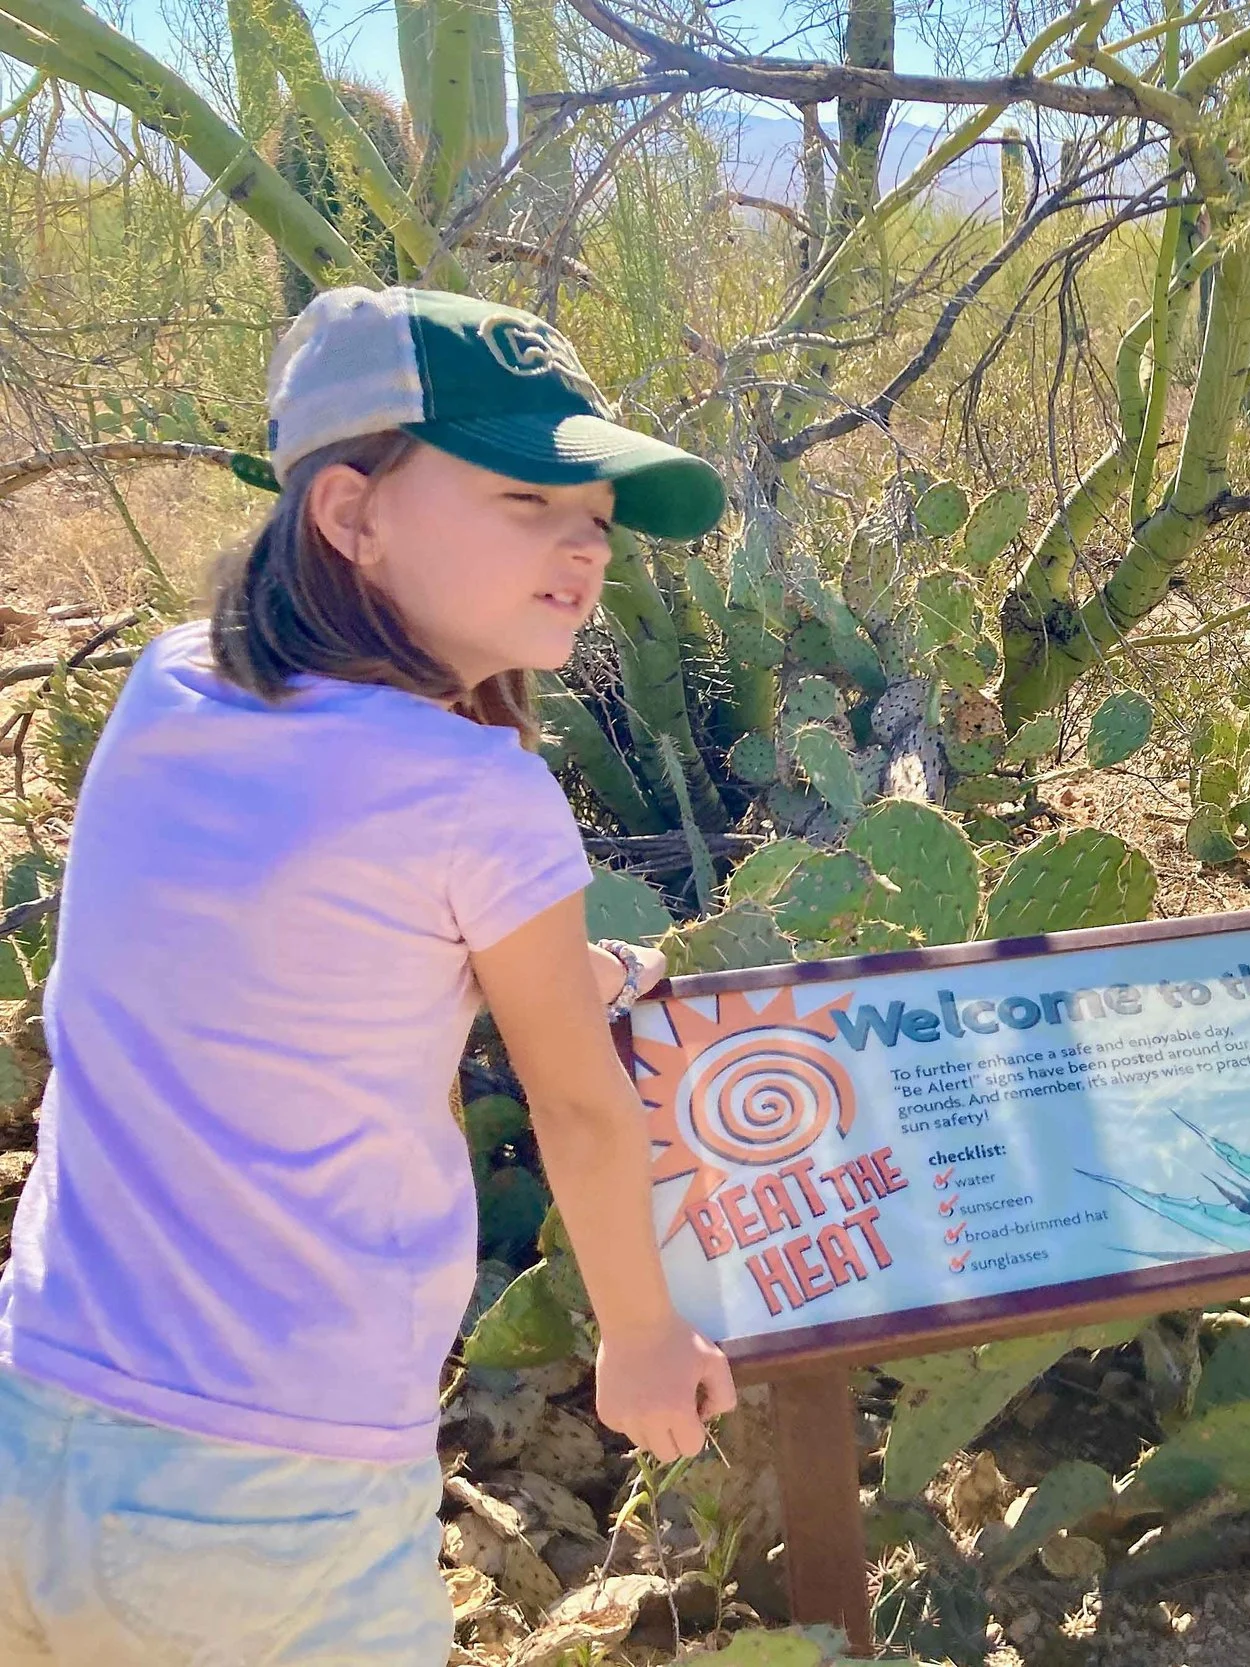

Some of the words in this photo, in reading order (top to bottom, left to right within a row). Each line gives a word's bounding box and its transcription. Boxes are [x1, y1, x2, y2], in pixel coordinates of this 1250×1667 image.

[830, 983, 1143, 1051] Welcome
[1156, 979, 1213, 1009] to
[890, 1068, 911, 1082] To
[915, 1061, 973, 1077] further
[977, 1050, 1044, 1070] enhance
[1047, 1050, 1057, 1060] a
[1061, 1042, 1093, 1058] safe
[1096, 1037, 1125, 1052] and
[1128, 1029, 1201, 1052] enjoyable
[984, 1069, 1025, 1087] signs
[1028, 1066, 1064, 1078] have
[1068, 1059, 1108, 1075] been
[1111, 1052, 1165, 1073] posted
[1168, 1042, 1222, 1060] around
[1224, 1040, 1250, 1051] our
[897, 1095, 967, 1120] grounds.
[968, 1091, 1001, 1106] And
[1003, 1078, 1085, 1101] remember,
[1111, 1067, 1159, 1086] always
[1161, 1064, 1195, 1077] wise
[1197, 1060, 1214, 1072] to
[900, 1121, 930, 1134] sun
[933, 1110, 989, 1130] safety!
[928, 1144, 1007, 1166] checklist:
[954, 1172, 996, 1188] water
[685, 1156, 828, 1262] BEAT
[819, 1145, 909, 1212] THE
[959, 1194, 1034, 1217] sunscreen
[964, 1212, 1081, 1242] broad-brimmed
[1084, 1208, 1109, 1222] hat
[744, 1205, 894, 1317] HEAT
[970, 1249, 1049, 1272] sunglasses
